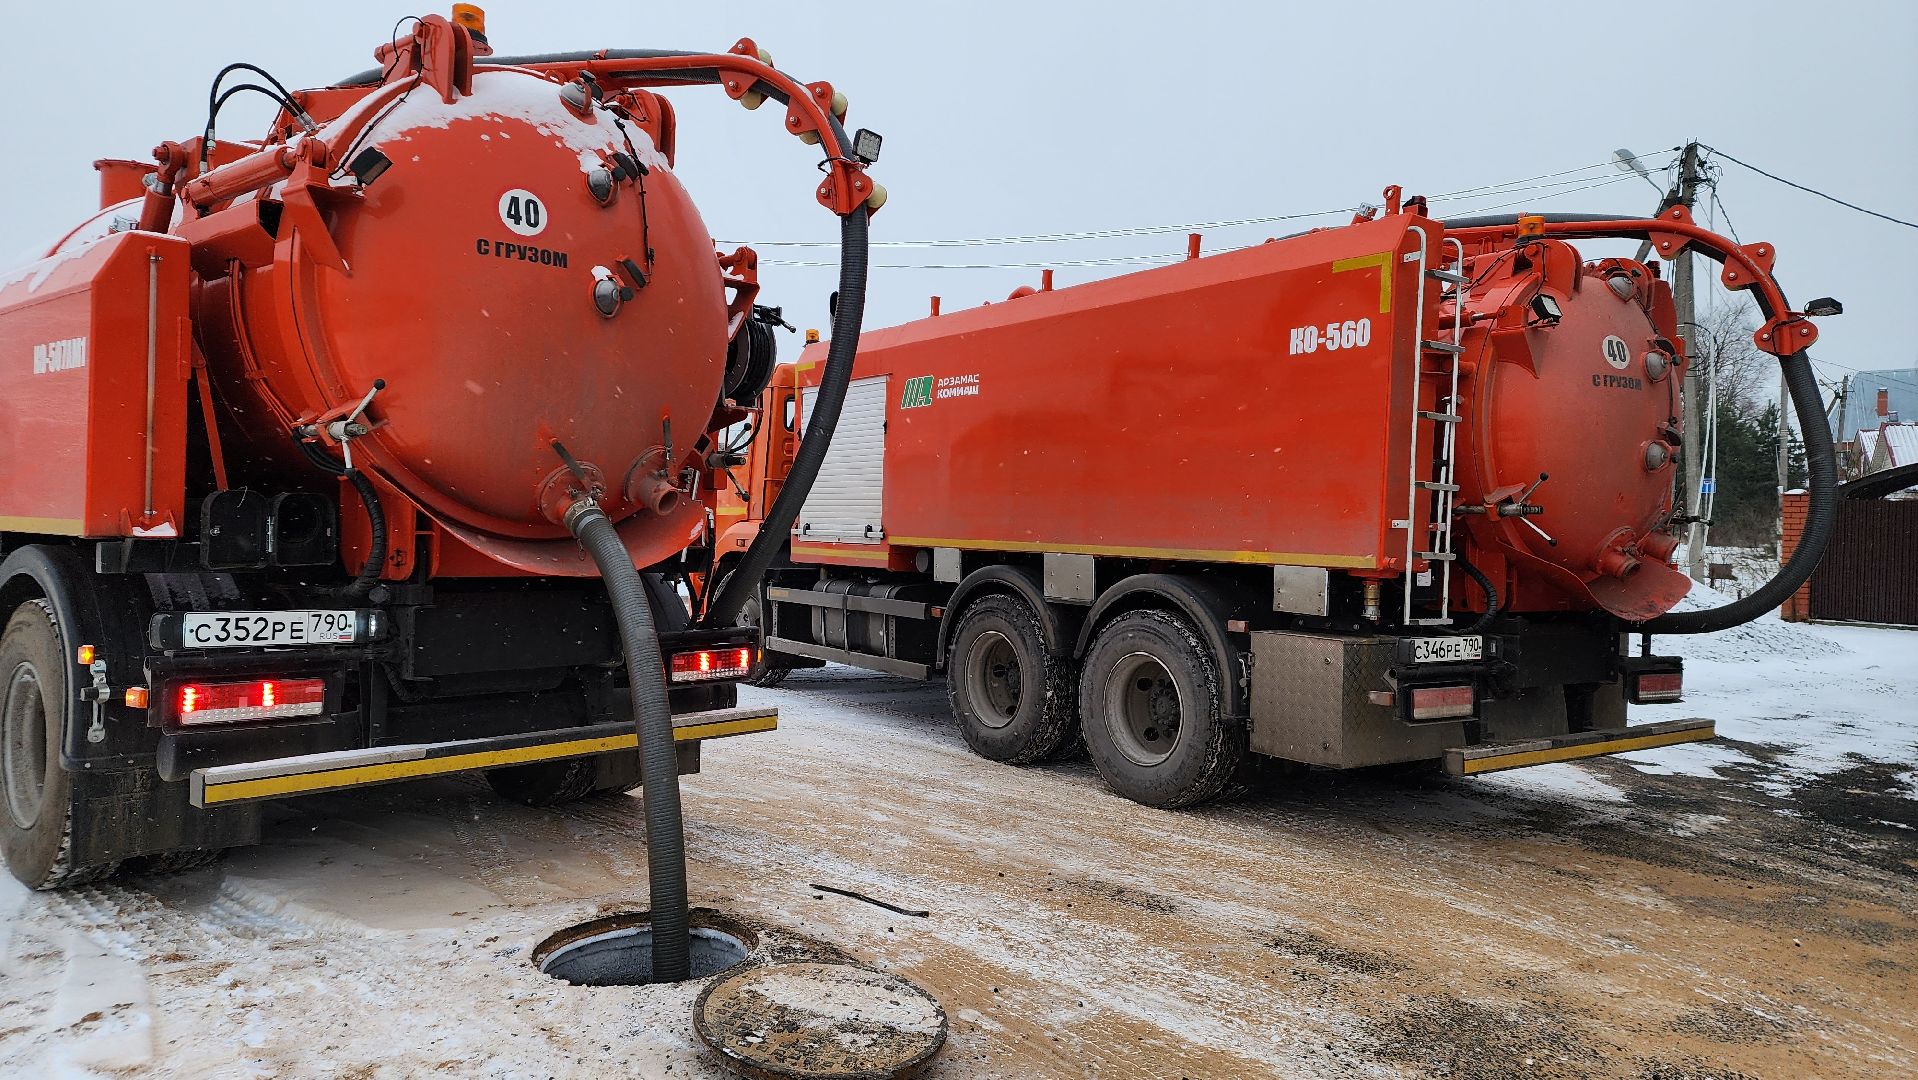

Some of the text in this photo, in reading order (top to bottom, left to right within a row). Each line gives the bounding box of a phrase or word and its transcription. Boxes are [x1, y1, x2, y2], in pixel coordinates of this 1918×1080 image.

[506, 196, 540, 228] 40
[476, 238, 568, 268] С ГРУЗОМ
[1289, 317, 1371, 355] КО-560
[1607, 339, 1627, 363] 40
[937, 373, 980, 388] АРЗАМАС
[1592, 374, 1642, 391] С ГРУЗОМ
[936, 384, 980, 399] КОММАШ
[311, 613, 348, 633] 790
[319, 632, 338, 640] RUS
[1462, 637, 1479, 652] 790
